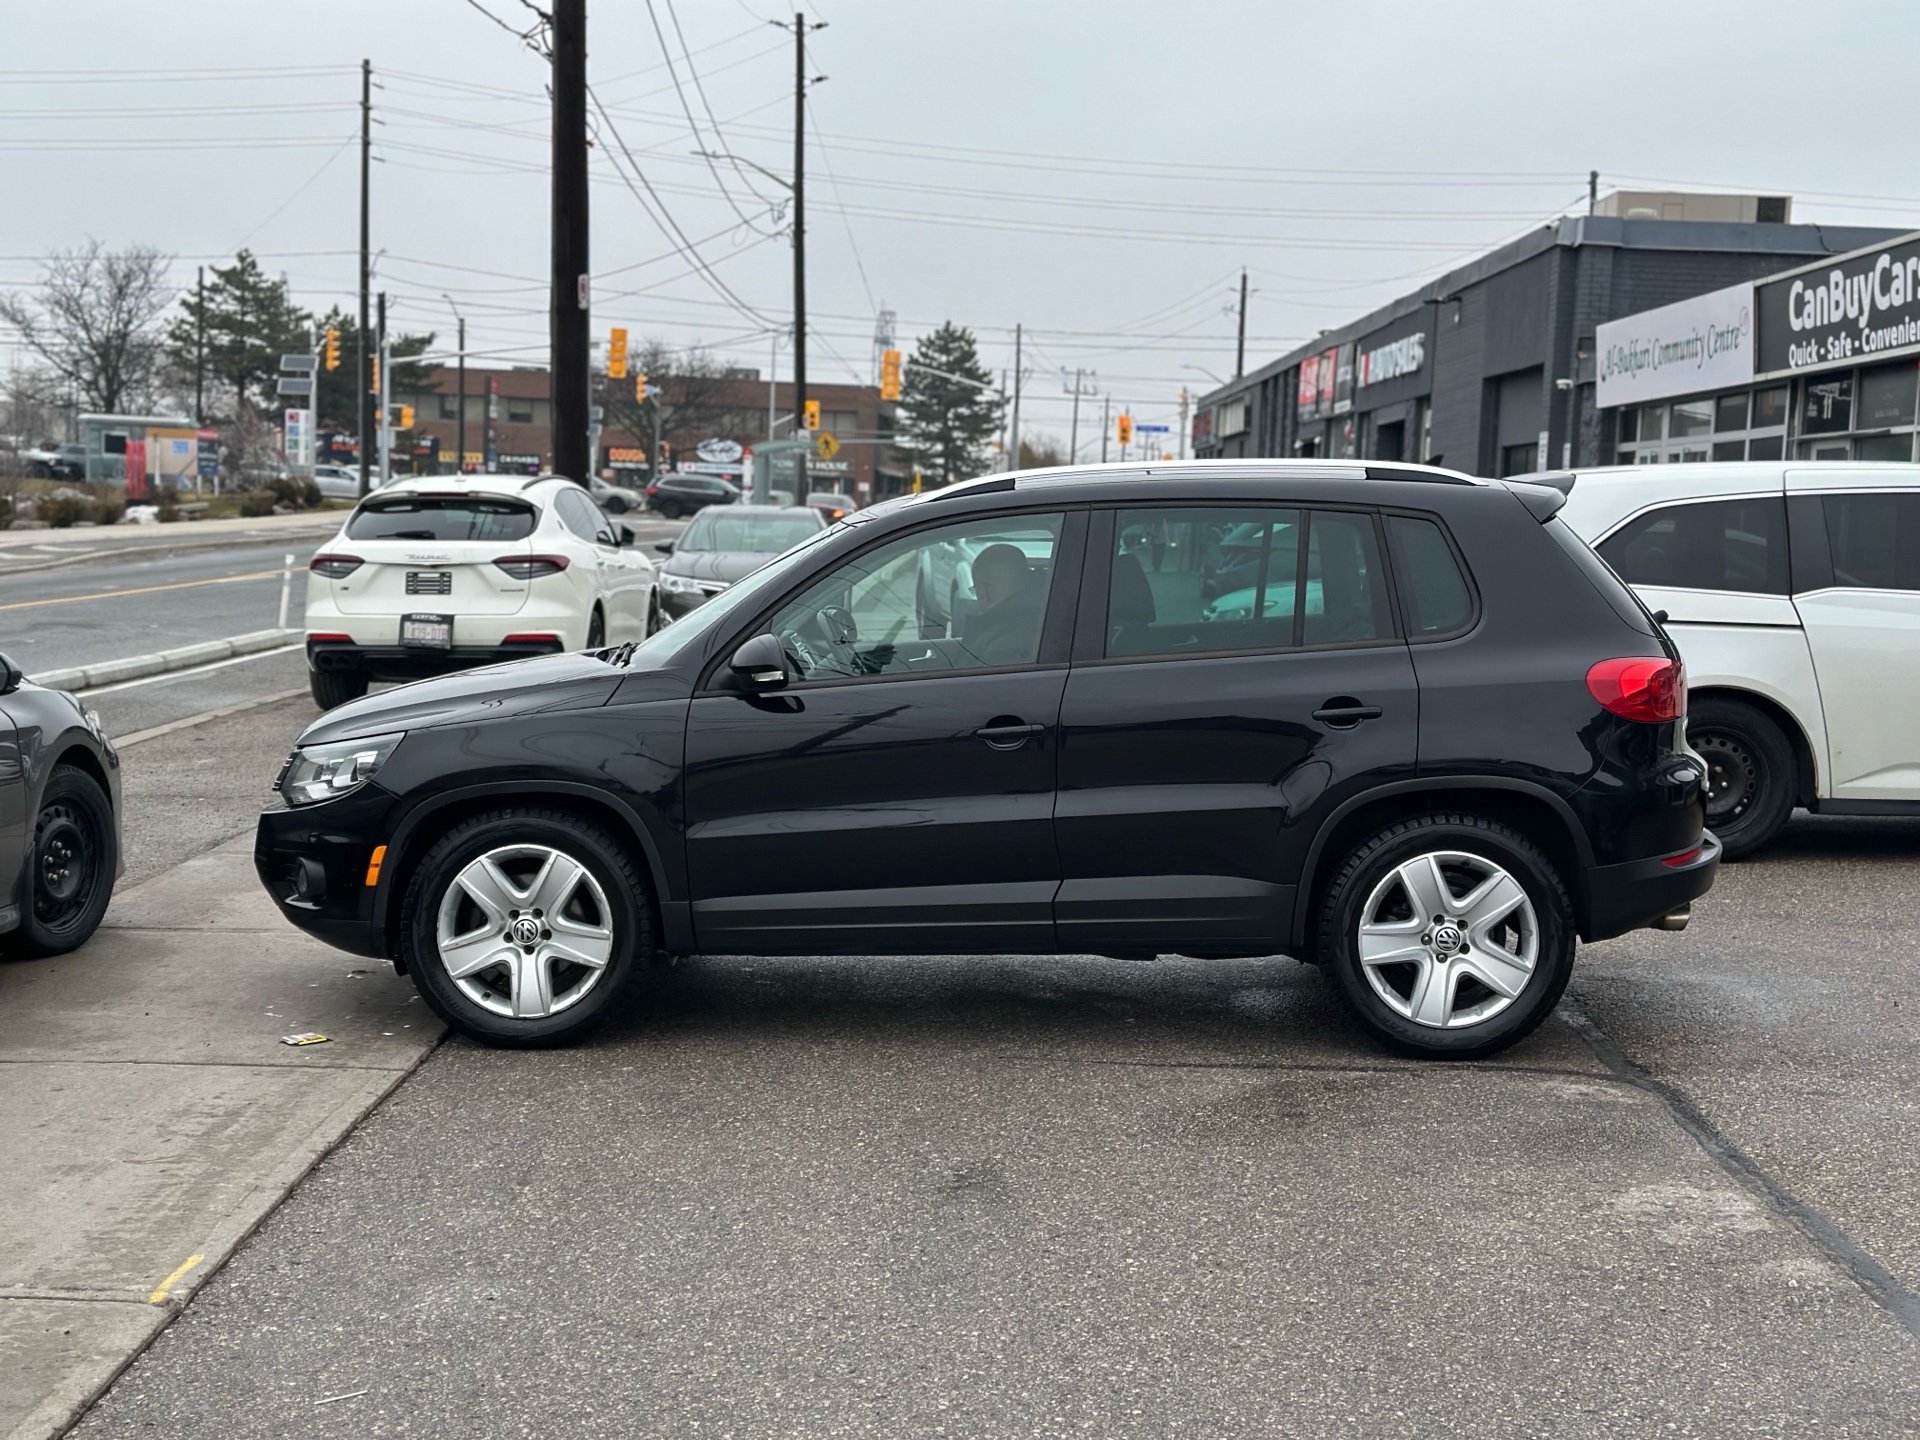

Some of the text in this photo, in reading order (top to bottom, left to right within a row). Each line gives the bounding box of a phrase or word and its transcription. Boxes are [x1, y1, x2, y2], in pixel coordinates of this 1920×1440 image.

[1789, 253, 1920, 331] CanBuyCar
[1652, 327, 1704, 370] Community
[1707, 323, 1740, 359] Centre
[1789, 338, 1818, 369] Quick
[1827, 331, 1852, 360] Safe
